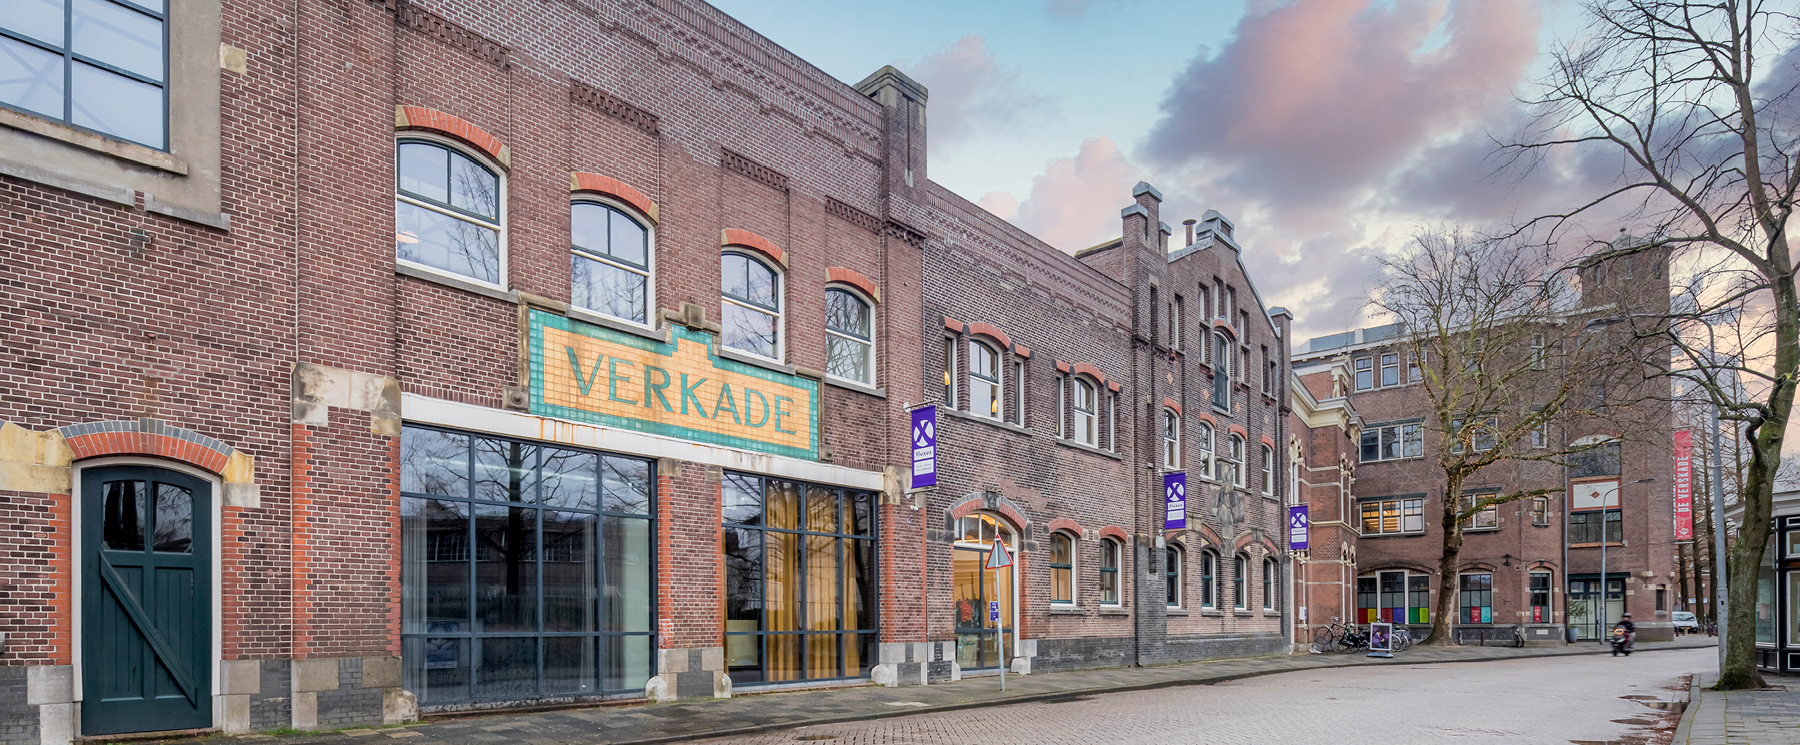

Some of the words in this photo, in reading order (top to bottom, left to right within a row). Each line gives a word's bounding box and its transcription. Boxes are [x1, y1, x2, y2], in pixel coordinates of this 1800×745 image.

[564, 346, 797, 435] VERKADE
[1677, 456, 1689, 499] VERSKADE
[1677, 502, 1690, 513] DE
